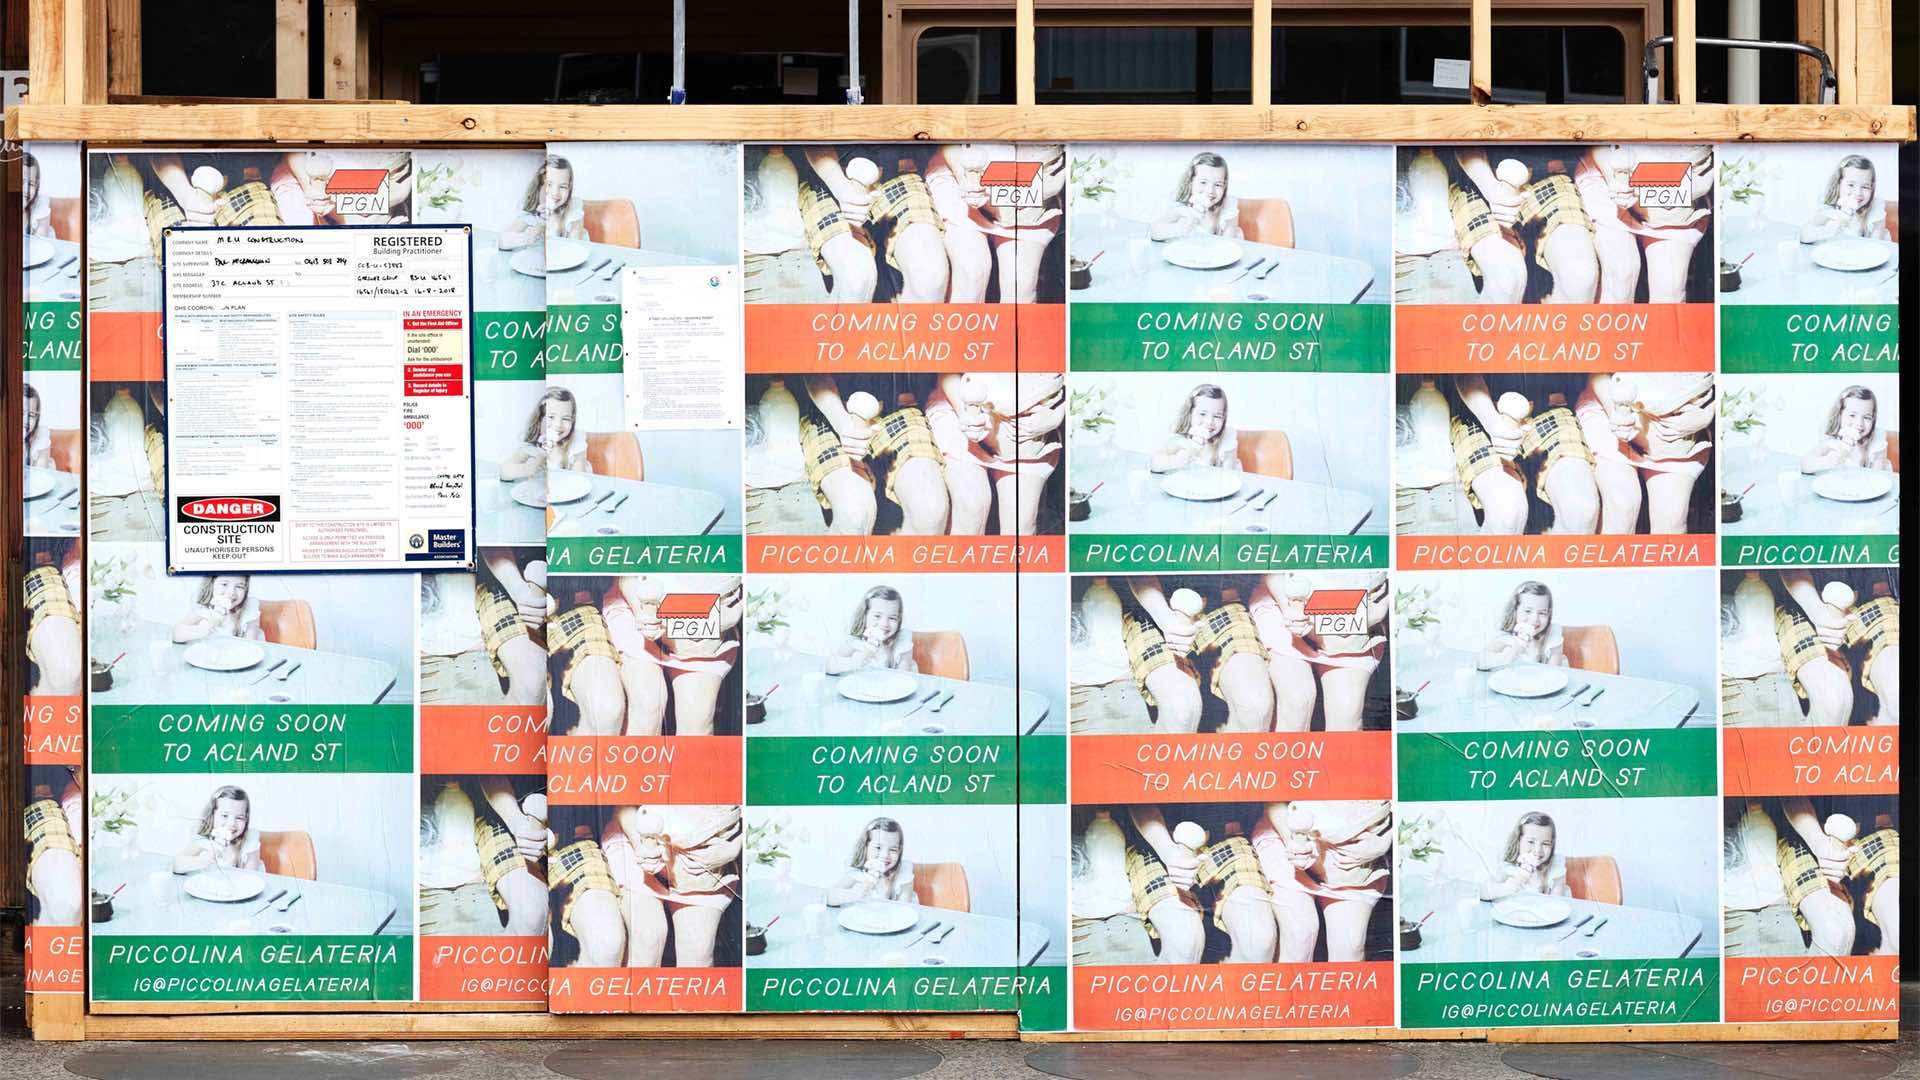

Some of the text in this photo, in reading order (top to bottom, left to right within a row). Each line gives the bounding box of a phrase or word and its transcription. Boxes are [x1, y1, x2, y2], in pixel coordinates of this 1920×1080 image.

[373, 236, 443, 247] REGISTERED
[373, 247, 442, 256] Building Practitioner
[812, 313, 999, 332] COMING SOON
[1137, 312, 1324, 331] COMING SOON
[1462, 313, 1648, 332] COMING SOON
[1787, 313, 1892, 333] COMING
[490, 350, 518, 369] TO
[817, 342, 994, 361] TO ACLAND ST
[1142, 341, 1319, 361] TO ACLAND ST
[1467, 342, 1643, 361] TO ACLAND ST
[1791, 343, 1819, 362] TO
[193, 503, 265, 515] DANGER
[183, 524, 275, 535] CONSTRUCTION
[217, 534, 242, 544] SITE
[433, 533, 457, 541] Master
[589, 545, 726, 565] GELATERIA
[761, 545, 1050, 564] PICCOLINA GELATERIA
[1086, 544, 1372, 563] PICCOLINA GELATERIA
[1414, 543, 1699, 564] PICCOLINA GELATERIA
[1738, 544, 1870, 564] PICCOLINA
[159, 713, 346, 733] COMING SOON
[163, 743, 342, 762] TO ACLAND ST
[492, 743, 520, 762] TO
[605, 745, 675, 764] SOON
[812, 745, 1000, 764] COMING SOON
[1137, 741, 1324, 762] COMING SOON
[1464, 738, 1650, 760] COMING SOON
[1789, 735, 1893, 755] COMING
[640, 774, 670, 793] ST
[1142, 770, 1320, 791] TO ACLAND ST
[1470, 767, 1646, 789] TO ACLAND ST
[1794, 764, 1899, 784] TO ACLA
[817, 774, 995, 794] TO ACLAND ST
[109, 944, 398, 964] PICCOLINA GELATERIA
[1090, 971, 1377, 993] PICCOLINA GELATERIA
[1417, 968, 1704, 991] PICCOLINA GELATERIA
[1741, 965, 1873, 985] PICCOLINA
[133, 977, 371, 993] IG@PICCOLINAGELATERIA
[589, 977, 726, 996] GELATERIA
[762, 975, 1051, 996] PICCOLINA GELATERIA
[1115, 1004, 1351, 1022] IG@PICCOLINAGELATERIA
[1442, 1000, 1677, 1019] IG@PICCOLINAGELATERIA
[1766, 998, 1897, 1013] IG@PICCOLINA
